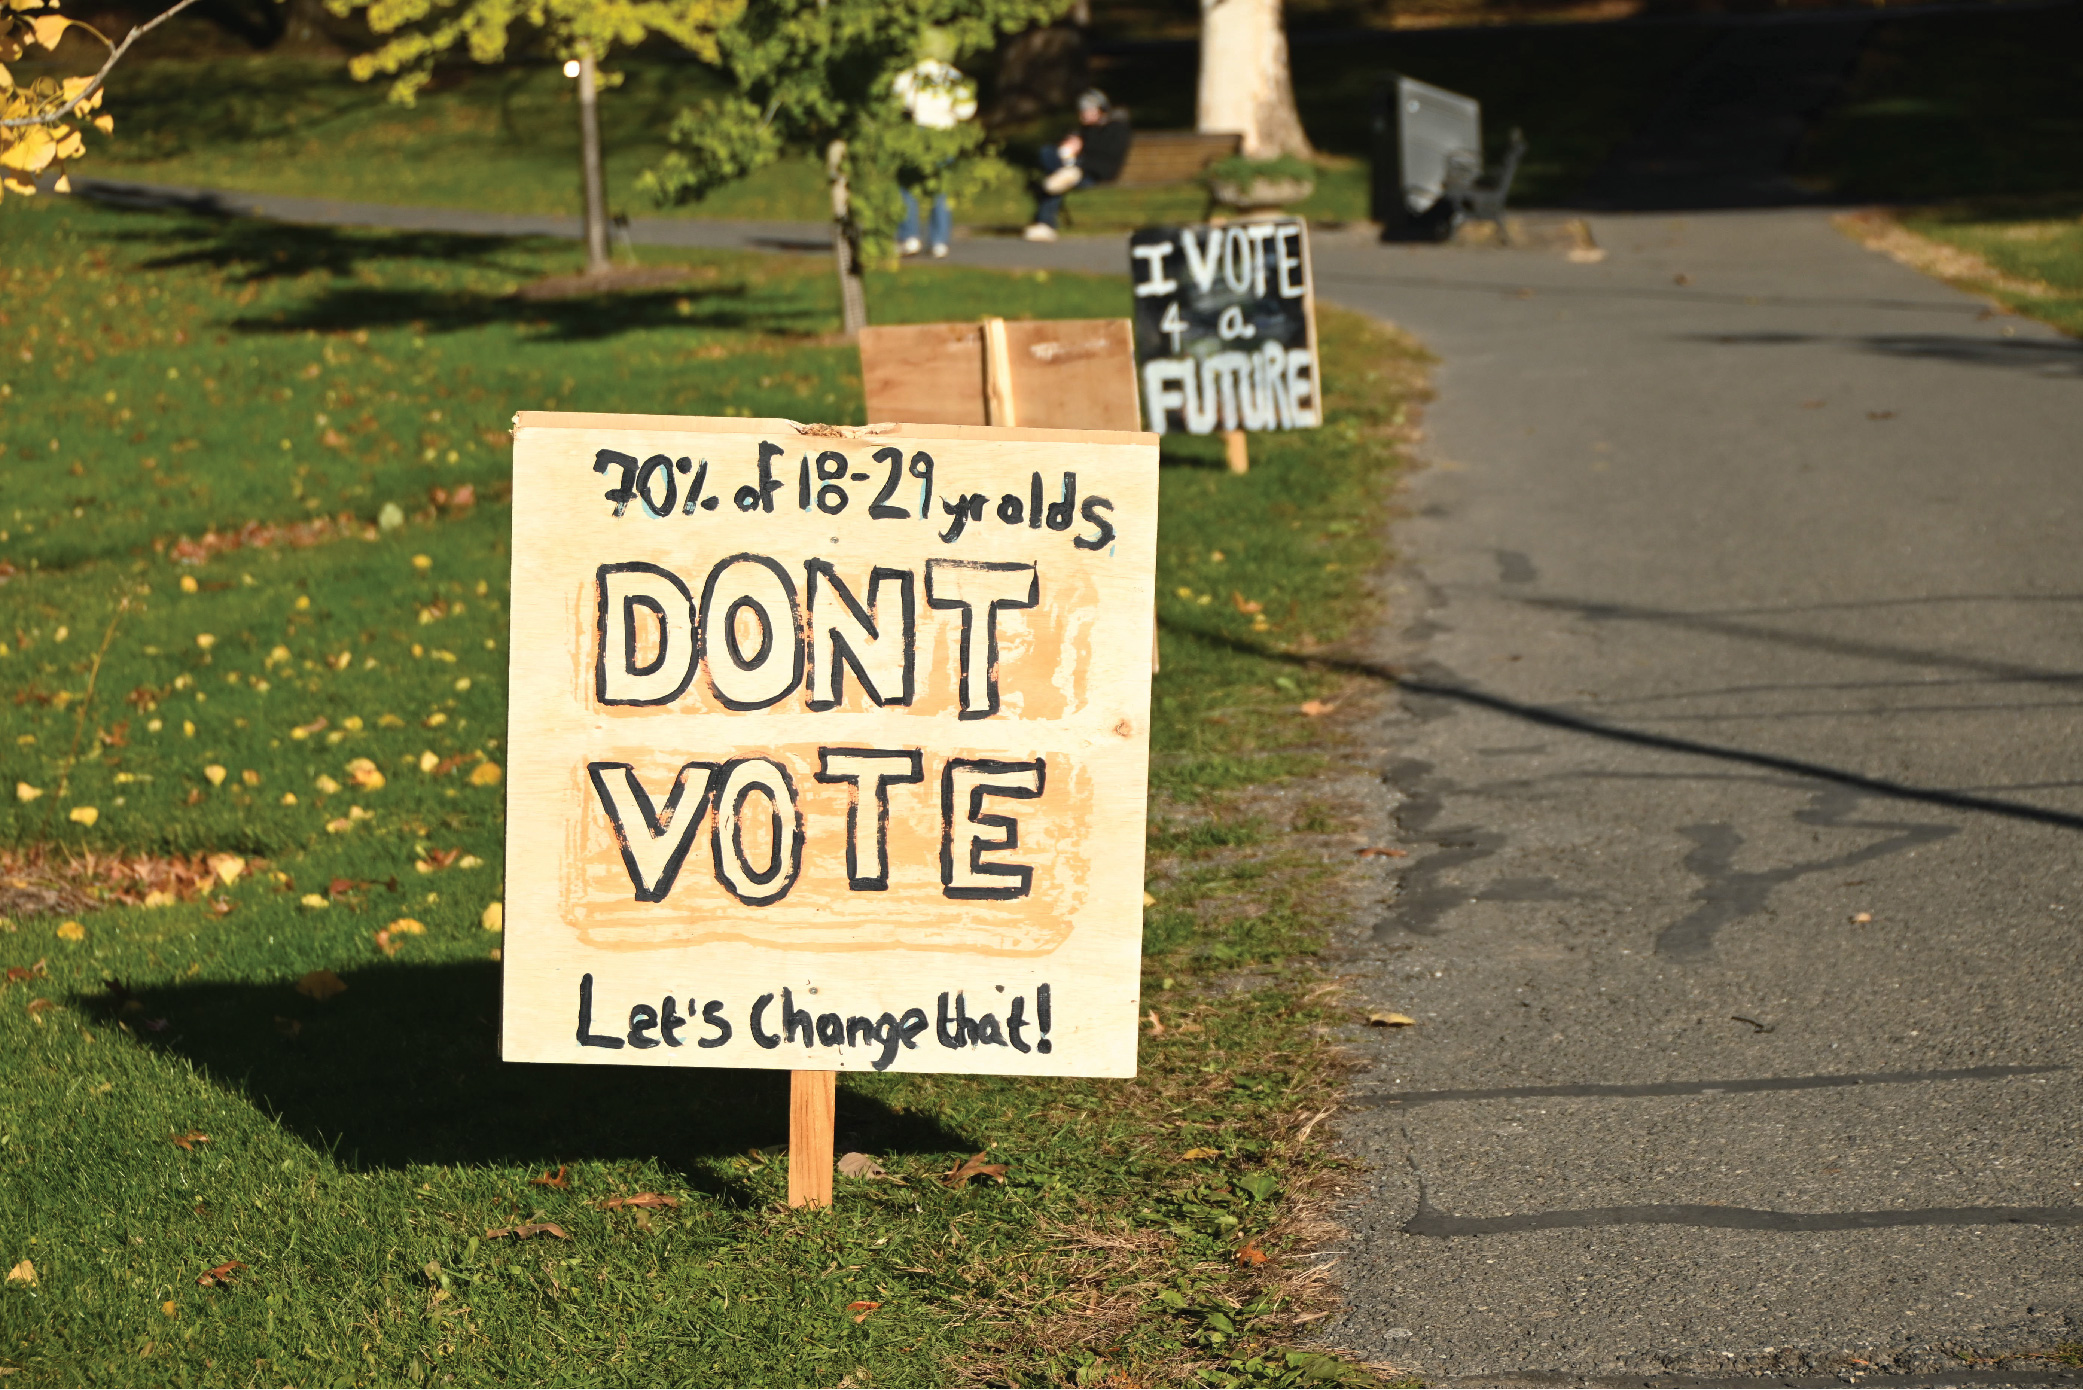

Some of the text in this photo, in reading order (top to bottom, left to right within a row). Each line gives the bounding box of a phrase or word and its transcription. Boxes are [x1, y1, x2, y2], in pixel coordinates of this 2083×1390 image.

[1131, 224, 1306, 299] I VOTE
[1159, 301, 1257, 353] 4 a
[1143, 339, 1319, 436] FUTURE
[593, 447, 720, 518] 70%
[734, 440, 784, 513] of
[799, 446, 934, 520] 18-29
[595, 552, 1039, 720] DONT
[587, 746, 1046, 907] VOTE
[576, 973, 1052, 1071] Let's Change that!
